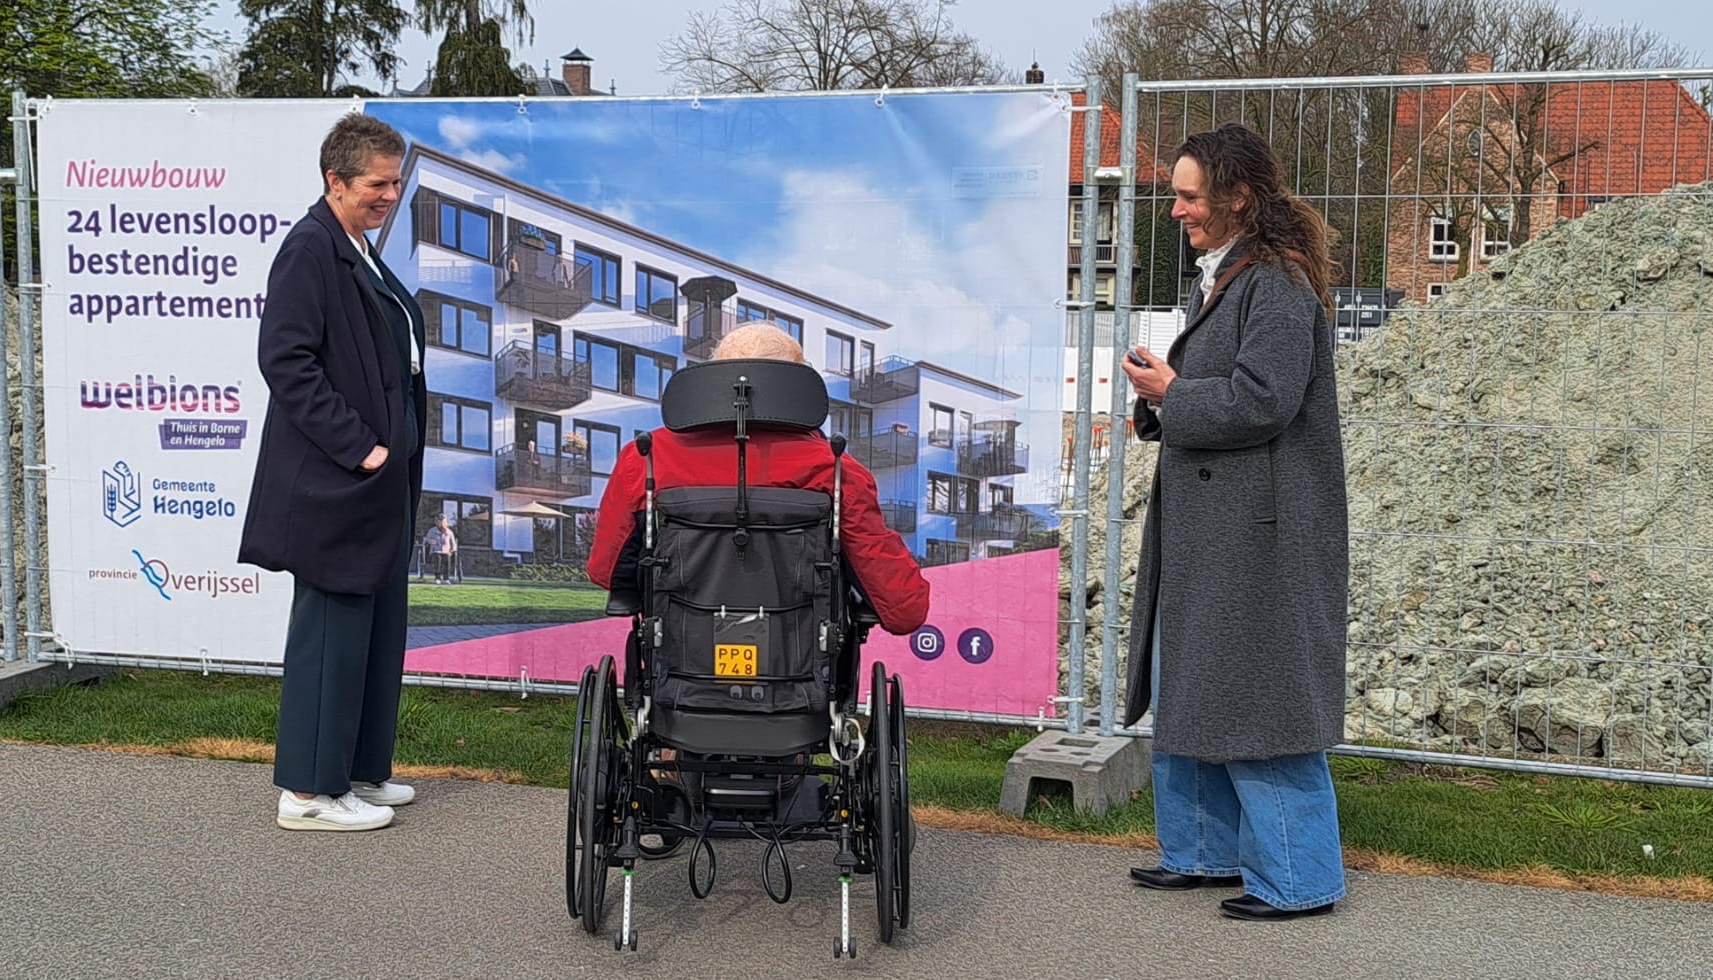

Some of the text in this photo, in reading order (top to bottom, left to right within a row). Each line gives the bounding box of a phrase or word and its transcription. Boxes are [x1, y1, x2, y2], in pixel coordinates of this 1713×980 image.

[66, 159, 225, 189] Nieuwbouw
[68, 204, 292, 242] 24 levensloop-
[68, 244, 237, 284] bestendige
[81, 374, 239, 412] welbions
[171, 421, 241, 435] Thuis in Borne
[170, 436, 226, 448] en Hengelo
[153, 478, 216, 492] Gemeente
[153, 495, 235, 519] Hengelo
[89, 568, 138, 580] provincie
[718, 663, 753, 675] 748
